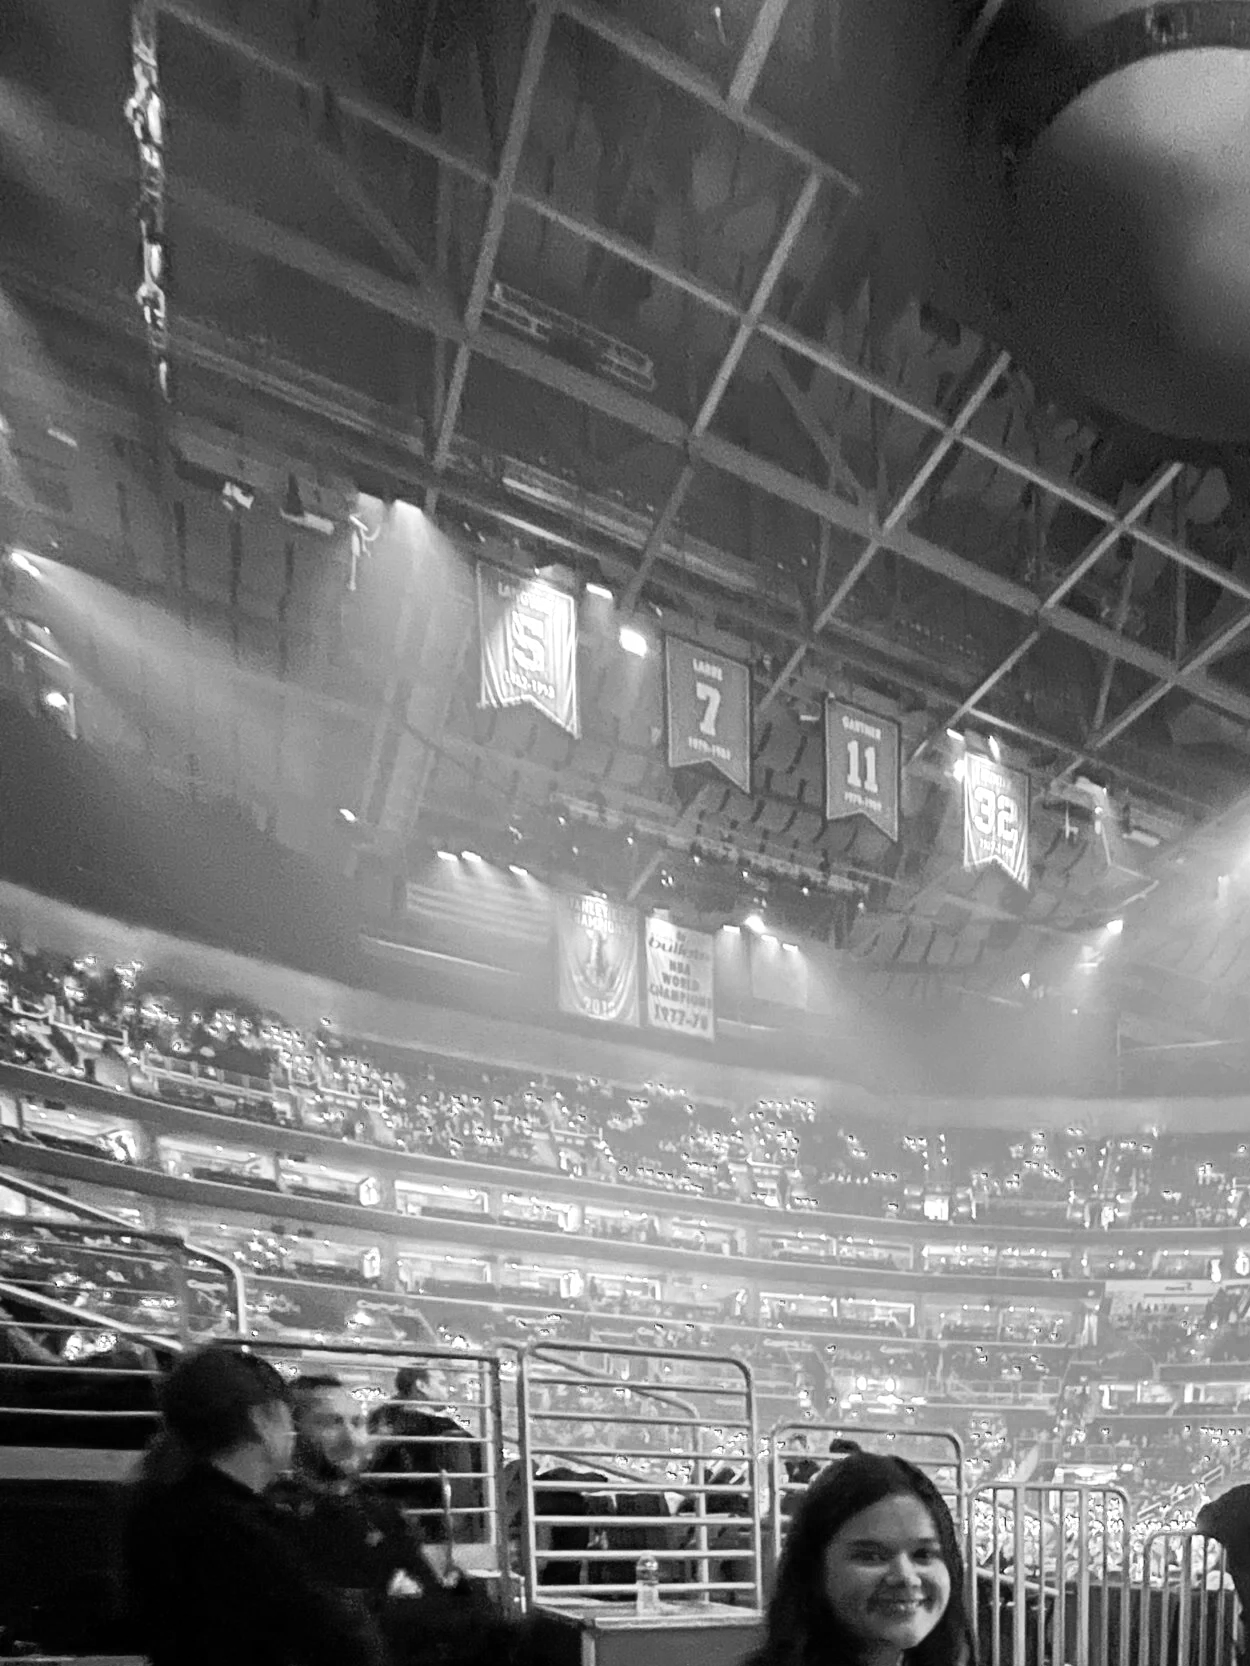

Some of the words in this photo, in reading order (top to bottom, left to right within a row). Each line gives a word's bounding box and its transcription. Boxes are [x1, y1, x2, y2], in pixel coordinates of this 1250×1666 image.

[512, 610, 545, 672] 5
[696, 681, 721, 736] 7
[847, 740, 879, 793] 11
[974, 786, 1019, 841] 32
[669, 959, 691, 977] NBA
